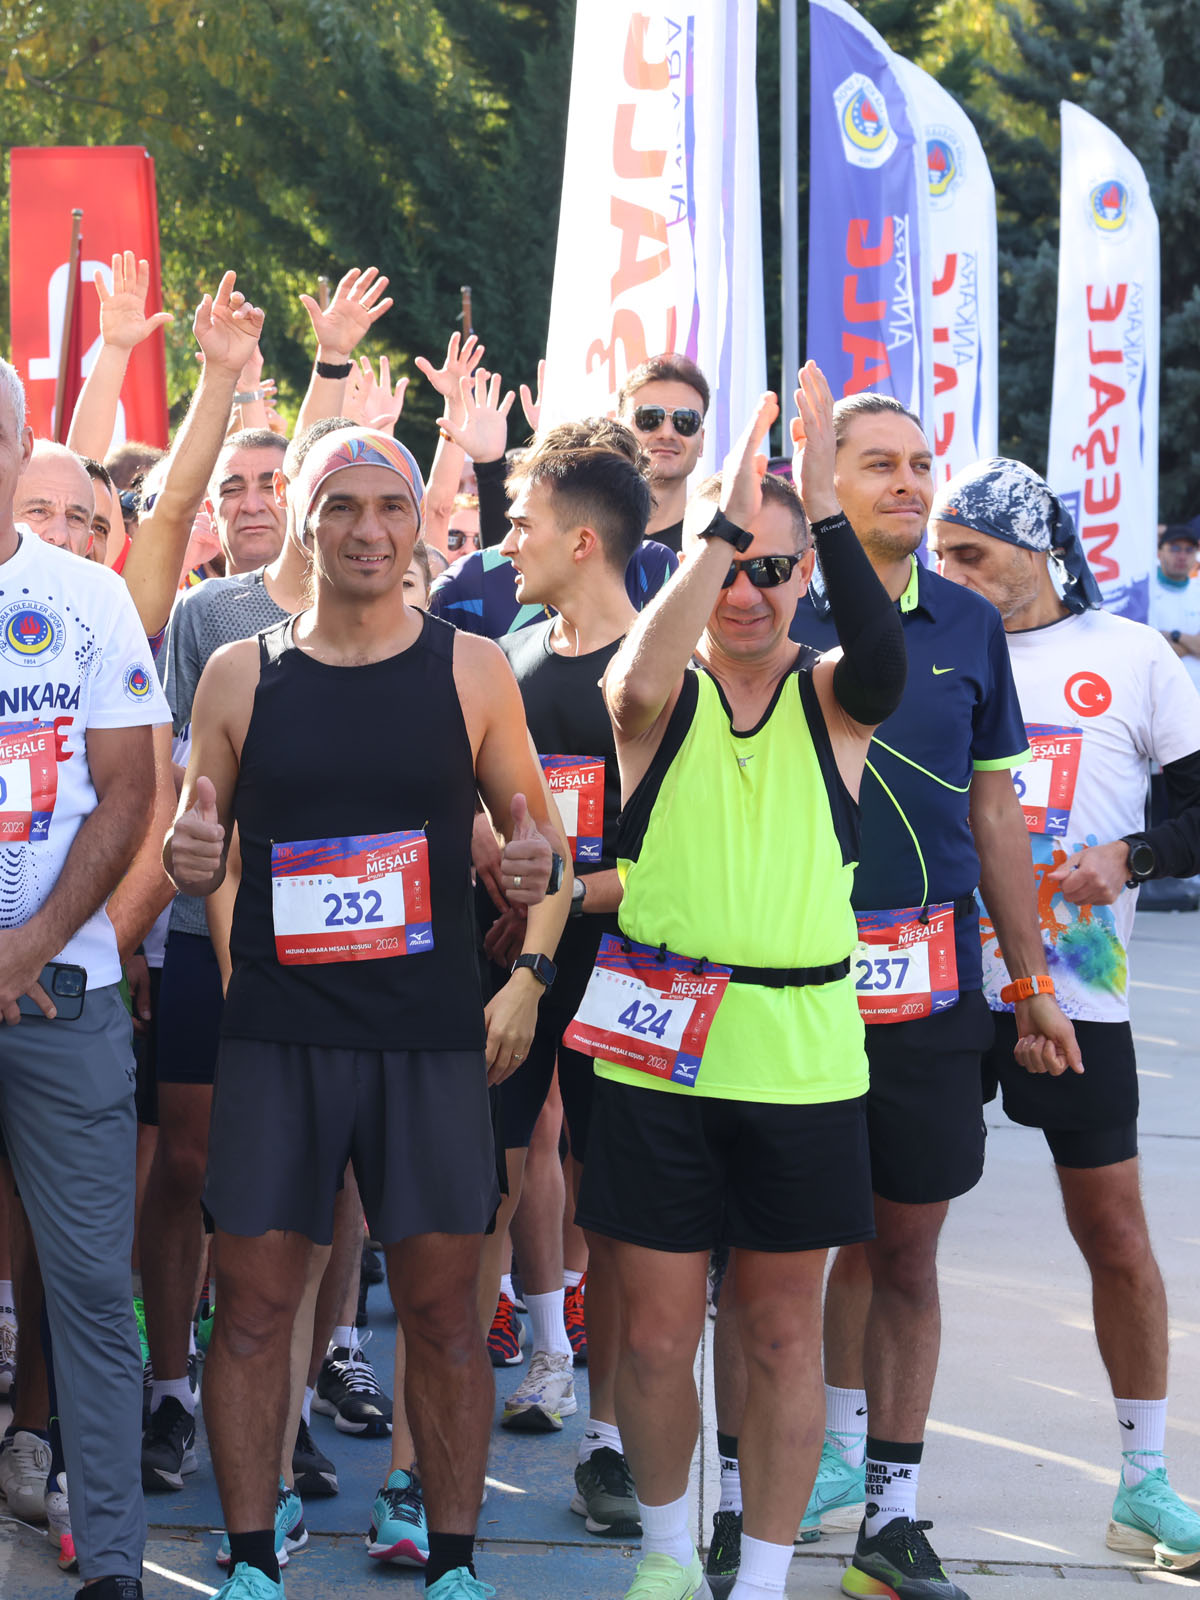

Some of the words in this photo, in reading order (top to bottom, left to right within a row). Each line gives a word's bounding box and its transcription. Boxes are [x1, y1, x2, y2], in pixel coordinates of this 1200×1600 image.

[1032, 743, 1071, 759] EŞALE
[548, 772, 595, 789] MEŞALE
[1, 822, 25, 833] 2023
[277, 846, 295, 859] 10K
[366, 849, 418, 875] MEŞALE
[323, 890, 384, 927] 232
[898, 921, 944, 945] MEŞALE
[305, 946, 328, 954] ANKARA
[328, 945, 350, 953] MEŞALE
[350, 943, 372, 951] KOŞUSU
[375, 937, 399, 950] 2023
[855, 957, 910, 991] 237
[670, 982, 718, 997] MEŞALE
[901, 1003, 924, 1016] 2023
[618, 999, 673, 1039] 424
[609, 1045, 628, 1057] MEŞALE
[647, 1054, 668, 1071] 2023
[892, 1468, 912, 1479] JE
